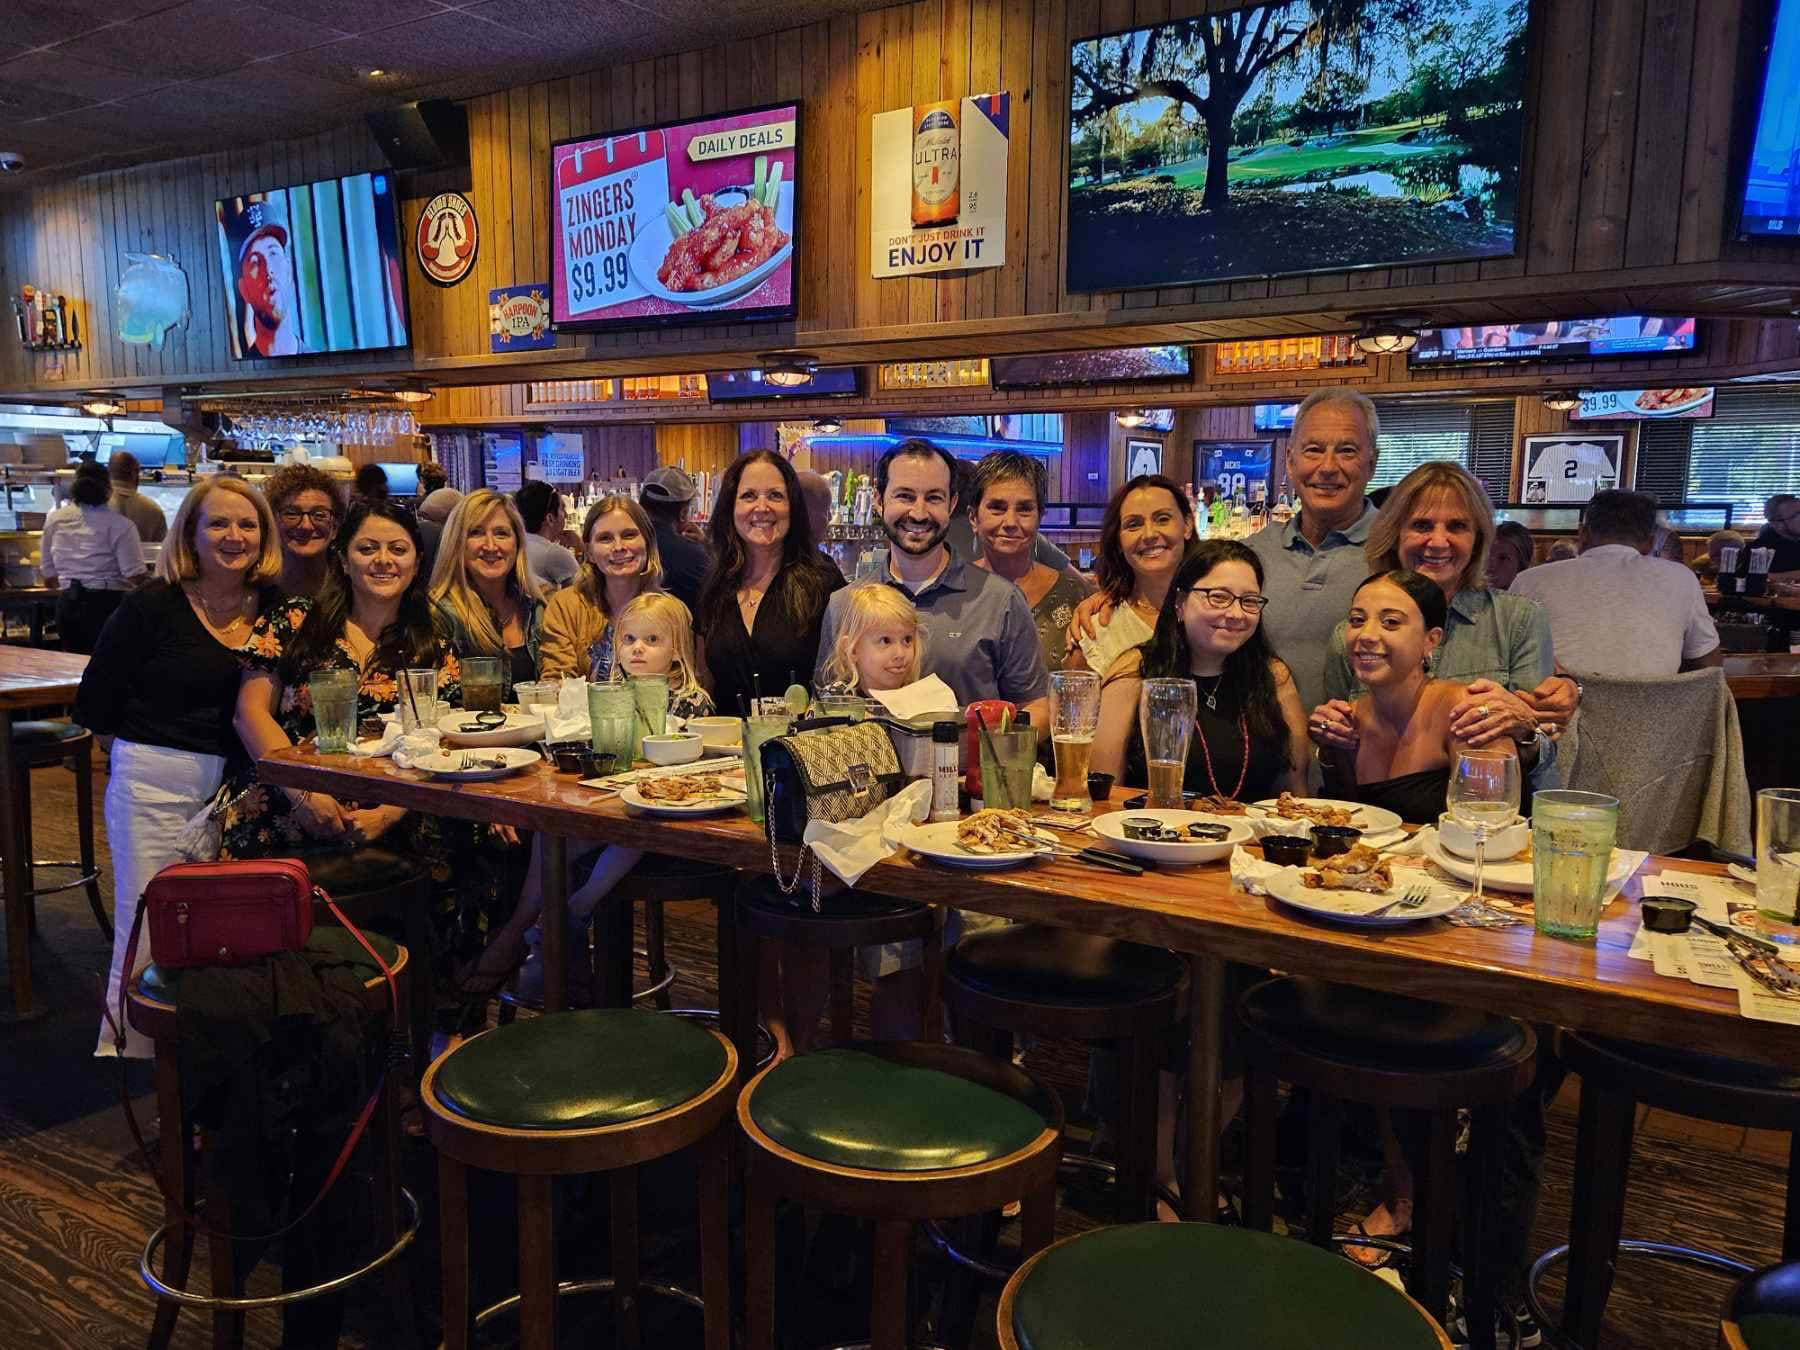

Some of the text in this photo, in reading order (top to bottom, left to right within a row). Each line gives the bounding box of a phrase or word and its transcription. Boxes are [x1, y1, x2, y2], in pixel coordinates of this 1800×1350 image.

[698, 128, 783, 155] DAILY DEALS
[915, 147, 958, 165] ULTRA
[566, 178, 635, 228] ZINGERS
[568, 212, 636, 260] MONDAY
[888, 226, 985, 246] DON'T JUST DRINK IT
[888, 238, 985, 267] ENJOY IT
[571, 252, 628, 302] $9.99
[502, 303, 538, 318] HARPOON
[512, 316, 530, 329] IPA
[1564, 459, 1578, 479] 2
